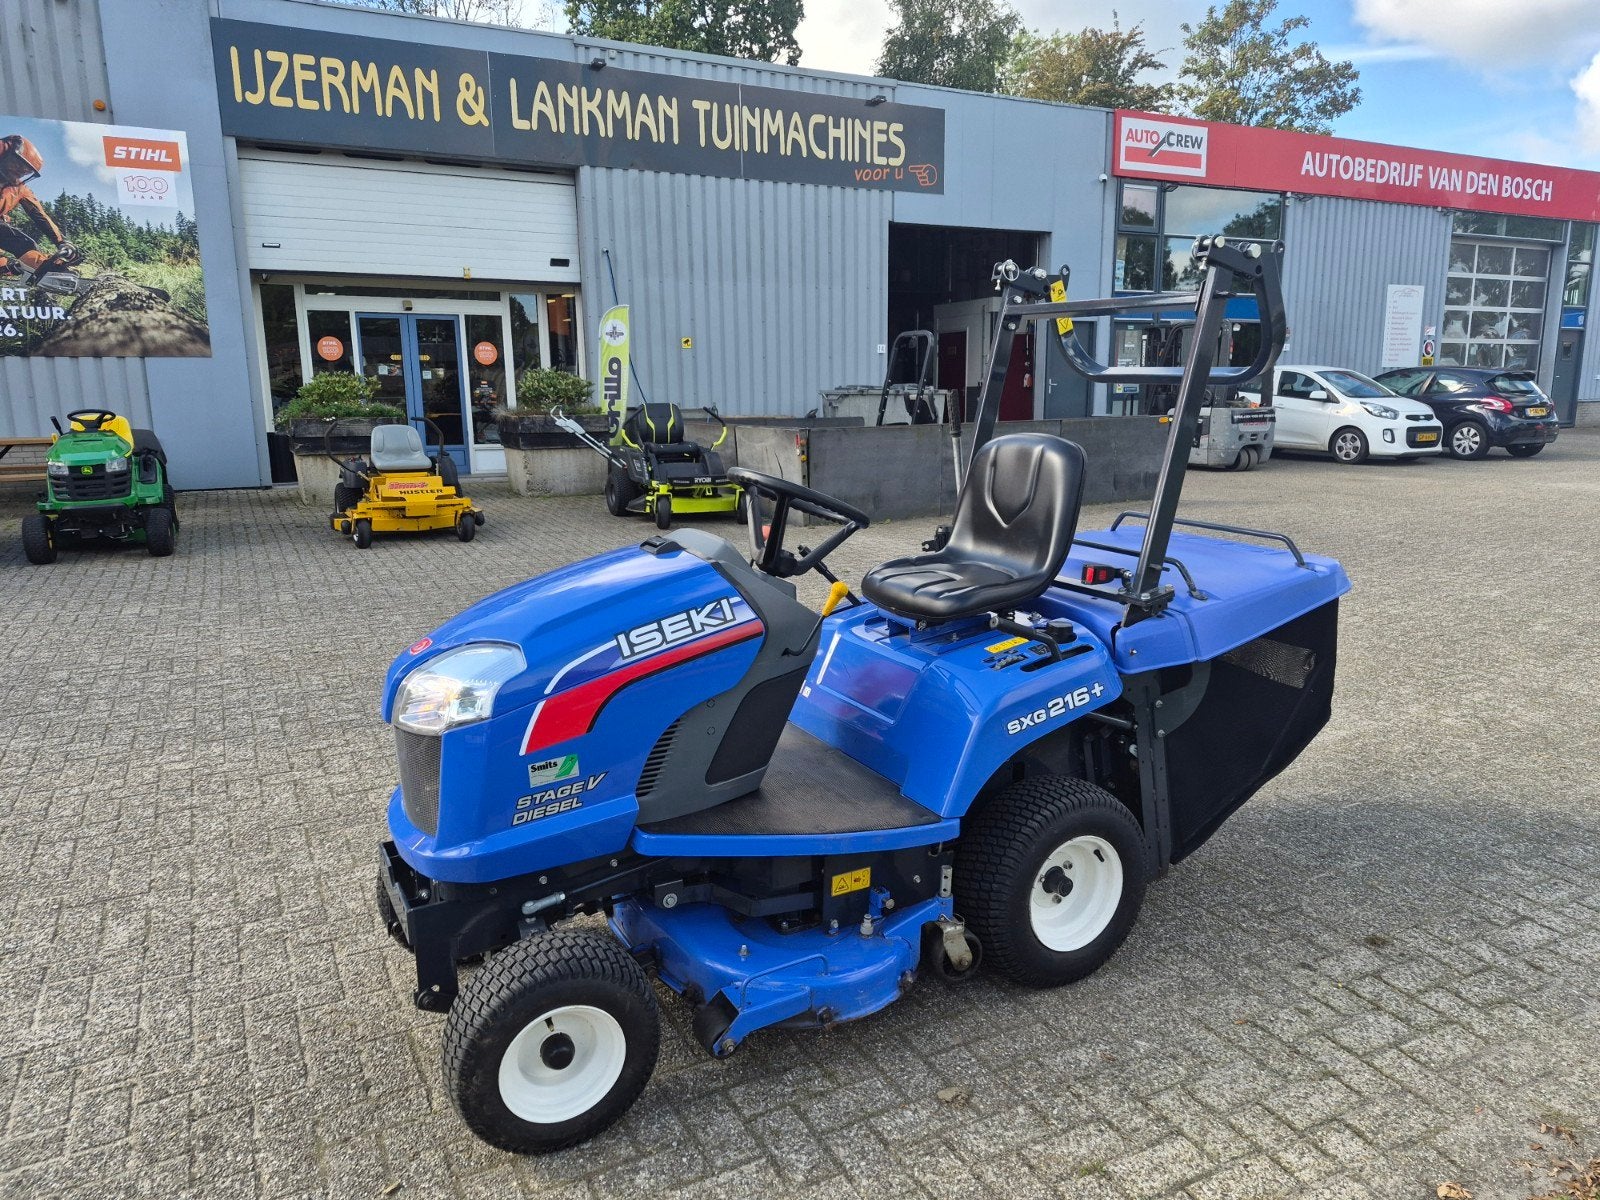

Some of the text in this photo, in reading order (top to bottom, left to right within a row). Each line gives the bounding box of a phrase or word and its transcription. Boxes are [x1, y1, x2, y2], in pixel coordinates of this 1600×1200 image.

[230, 45, 906, 167] IJZERMAN & LANKMAN TUINMACHINES
[113, 146, 173, 163] STIHL
[123, 175, 169, 195] 100
[854, 166, 904, 182] voor u
[1300, 151, 1553, 202] AUTOBEDRIJF VAN DEN BOSCH
[0, 287, 28, 302] RT
[615, 597, 735, 659] ISEKI
[1006, 708, 1047, 735] SXG
[530, 760, 558, 773] Smits
[515, 771, 609, 810] STAGE V
[511, 796, 583, 826] DIESEL
